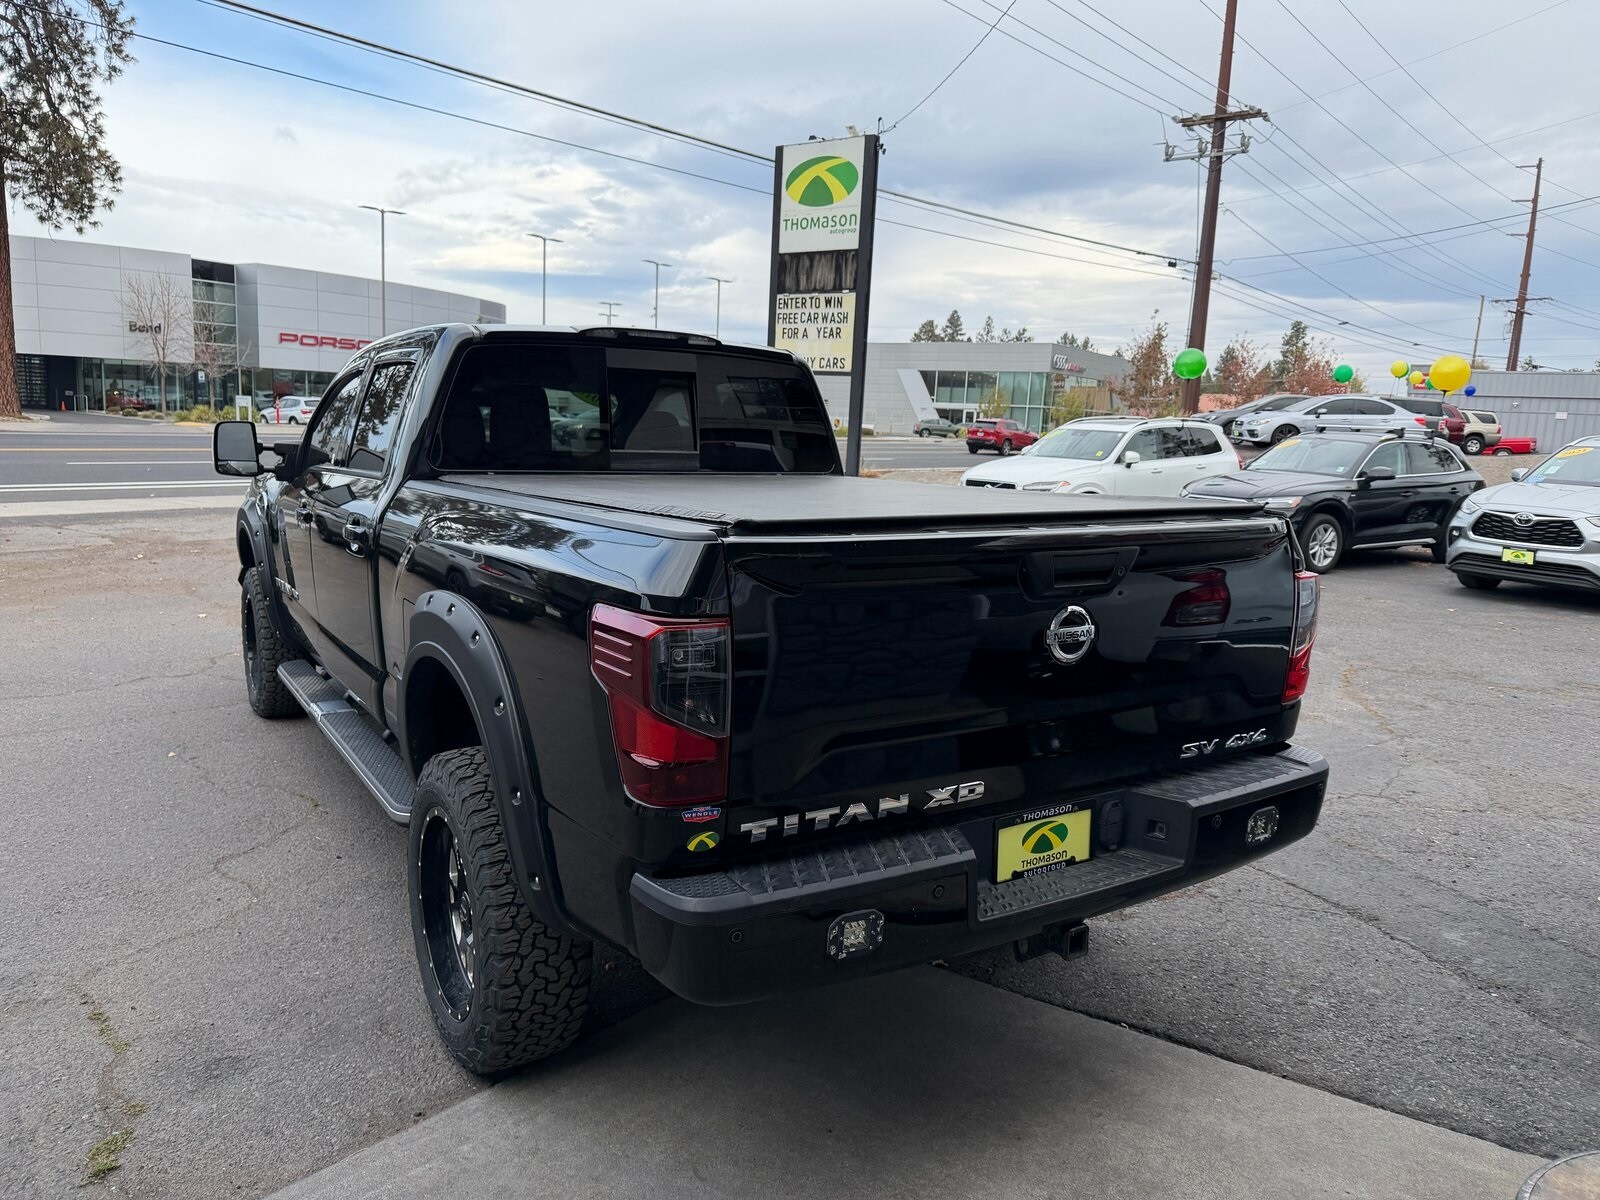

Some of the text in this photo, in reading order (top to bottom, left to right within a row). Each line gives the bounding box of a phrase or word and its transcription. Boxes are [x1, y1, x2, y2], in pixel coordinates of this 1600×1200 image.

[778, 296, 843, 310] ENTER TO WIN
[777, 312, 849, 325] FREE CAR WASH
[128, 320, 162, 334] Bend
[782, 327, 842, 339] FOR A YEAR
[819, 357, 846, 369] CARS
[1053, 629, 1092, 641] NISSAN
[1180, 738, 1220, 759] SV
[684, 810, 718, 818] WENDLE
[740, 781, 985, 843] TITAN XD
[1023, 861, 1066, 878] autogroup
